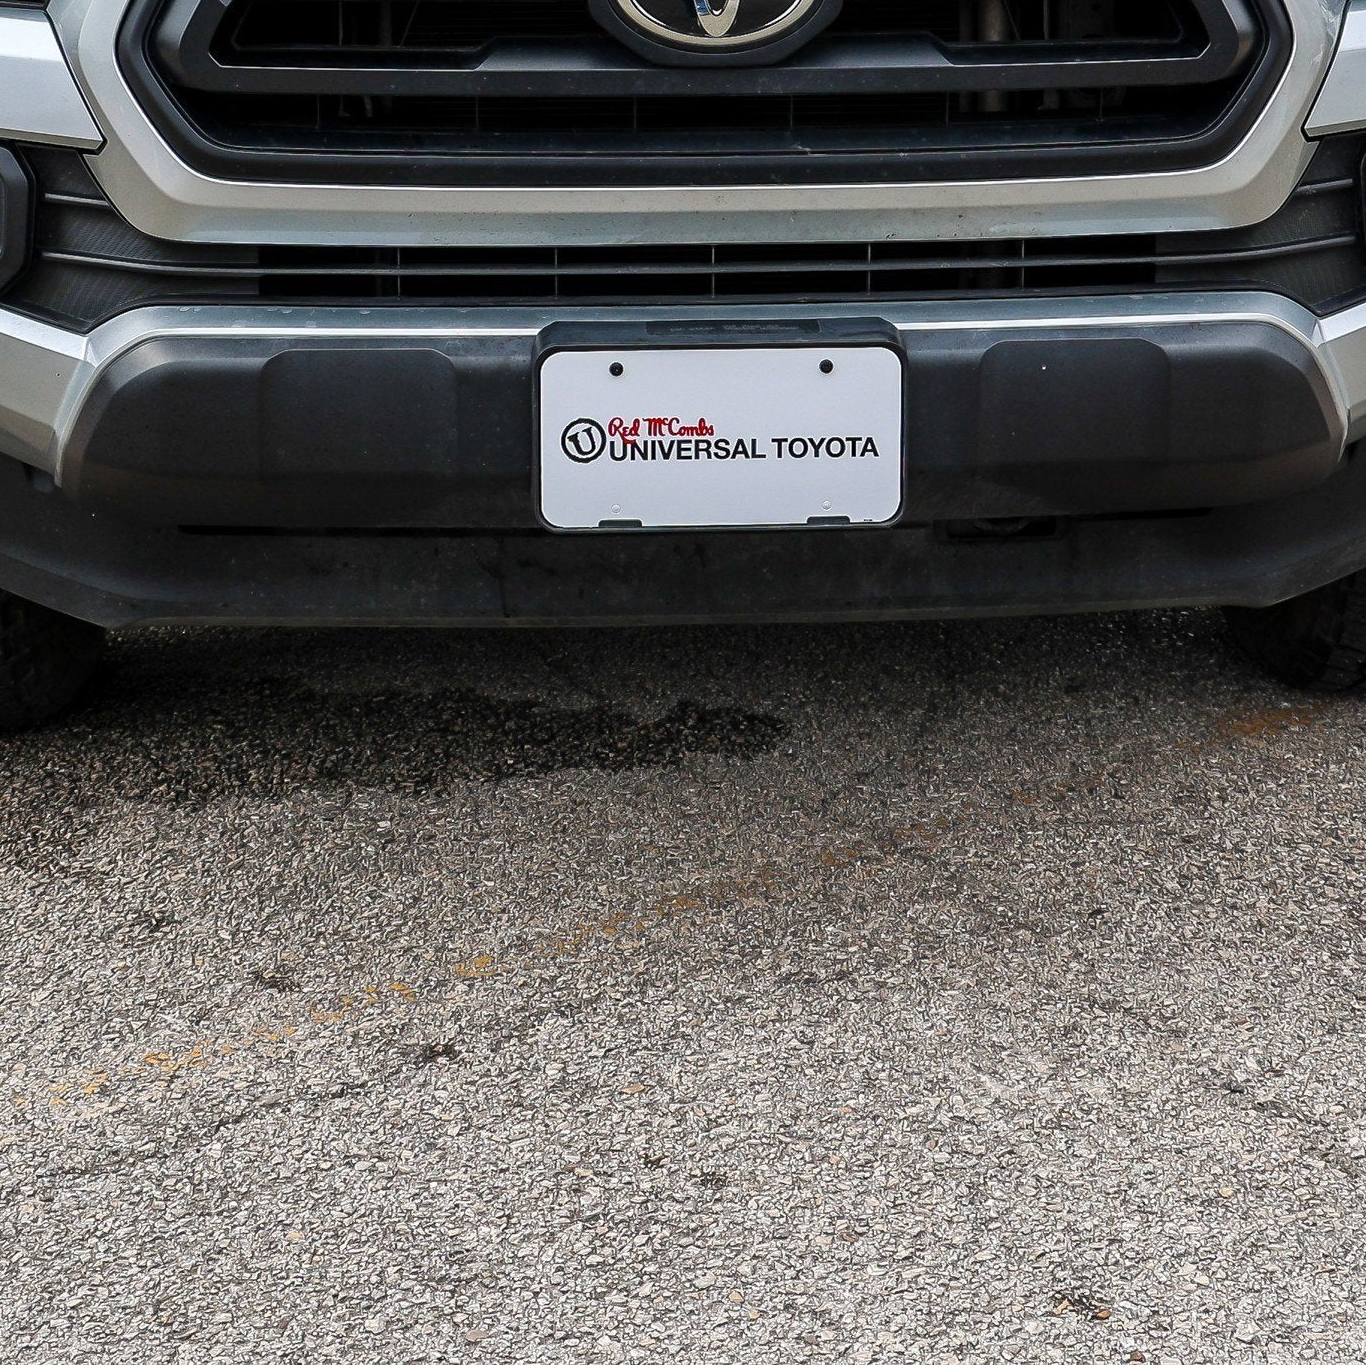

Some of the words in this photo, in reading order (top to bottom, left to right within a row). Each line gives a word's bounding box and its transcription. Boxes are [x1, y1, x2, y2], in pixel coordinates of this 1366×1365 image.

[608, 417, 641, 444] Red
[642, 417, 714, 437] McCombs
[609, 438, 767, 461] UNIVERSAL
[771, 437, 880, 459] TOYOTA
